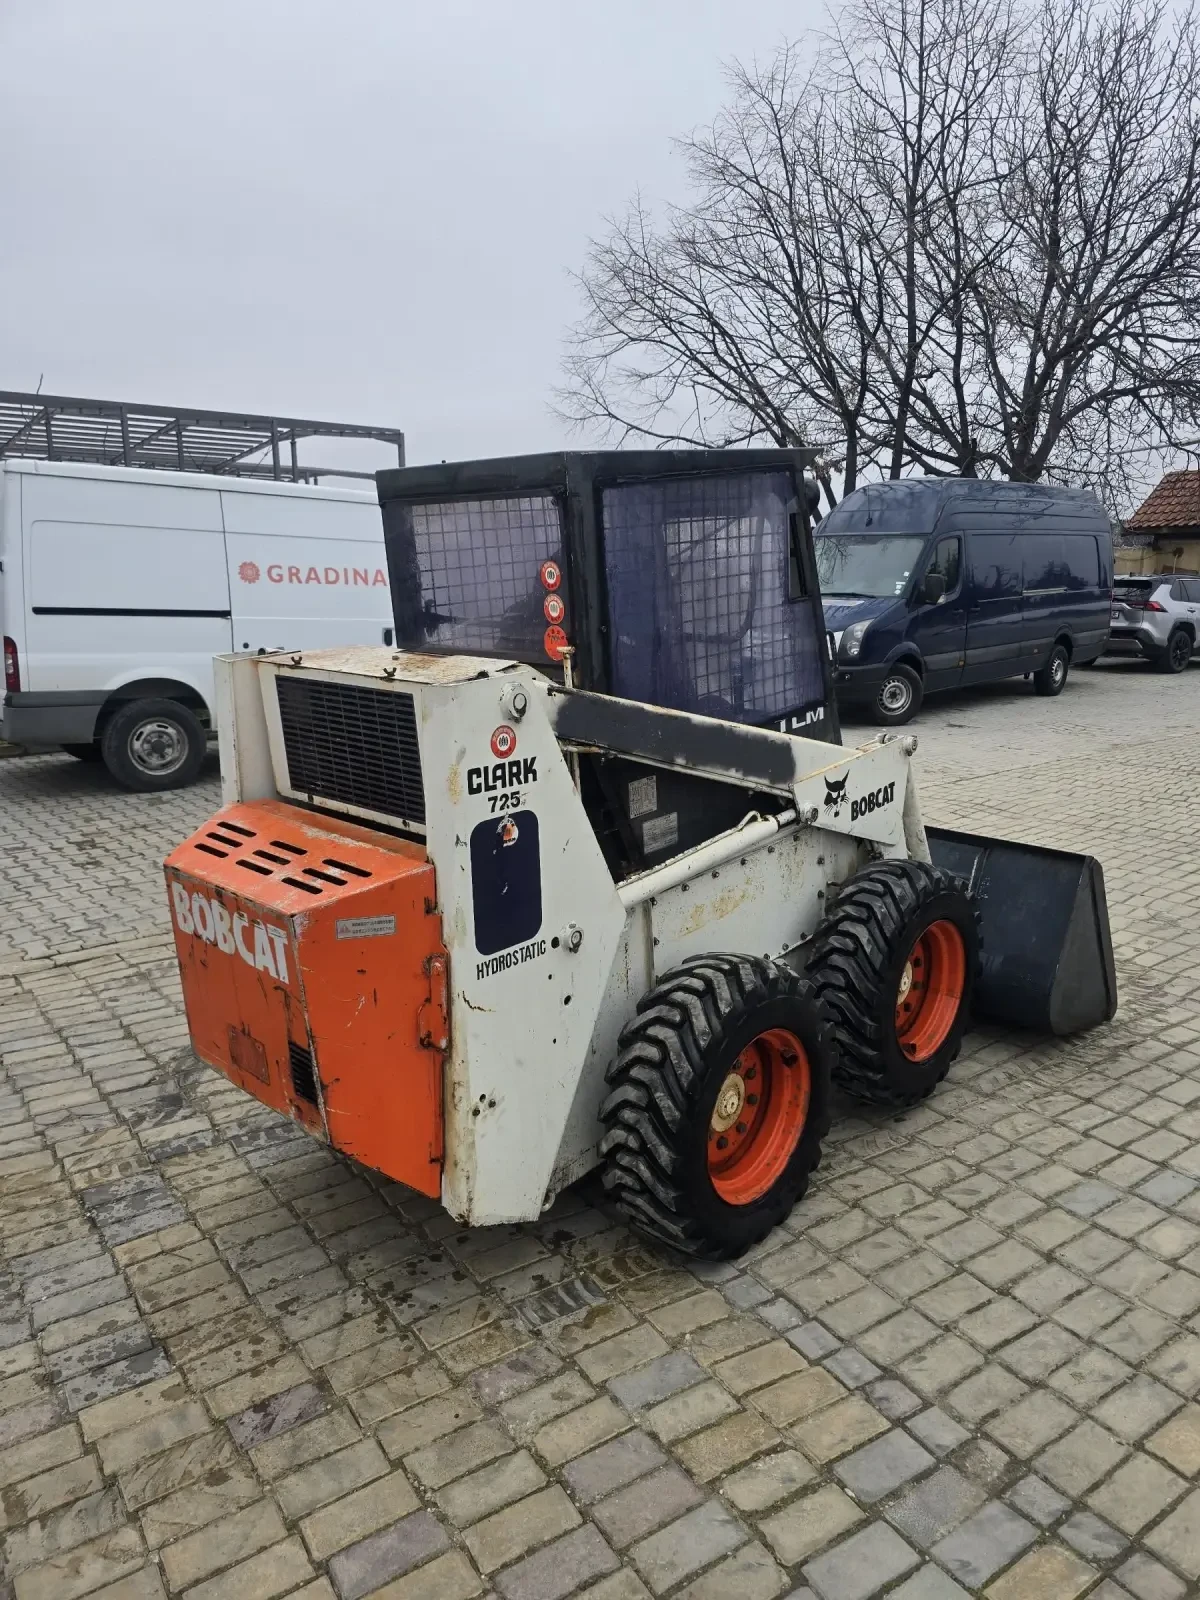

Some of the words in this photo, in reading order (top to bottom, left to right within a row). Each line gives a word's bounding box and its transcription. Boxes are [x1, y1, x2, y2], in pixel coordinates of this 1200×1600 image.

[266, 564, 388, 587] GRADINA
[467, 756, 538, 795] CLARK
[487, 790, 521, 813] 725
[850, 781, 896, 821] BOBCAT
[171, 879, 290, 985] BOBCAT
[476, 939, 546, 981] HYDROSTATIC
